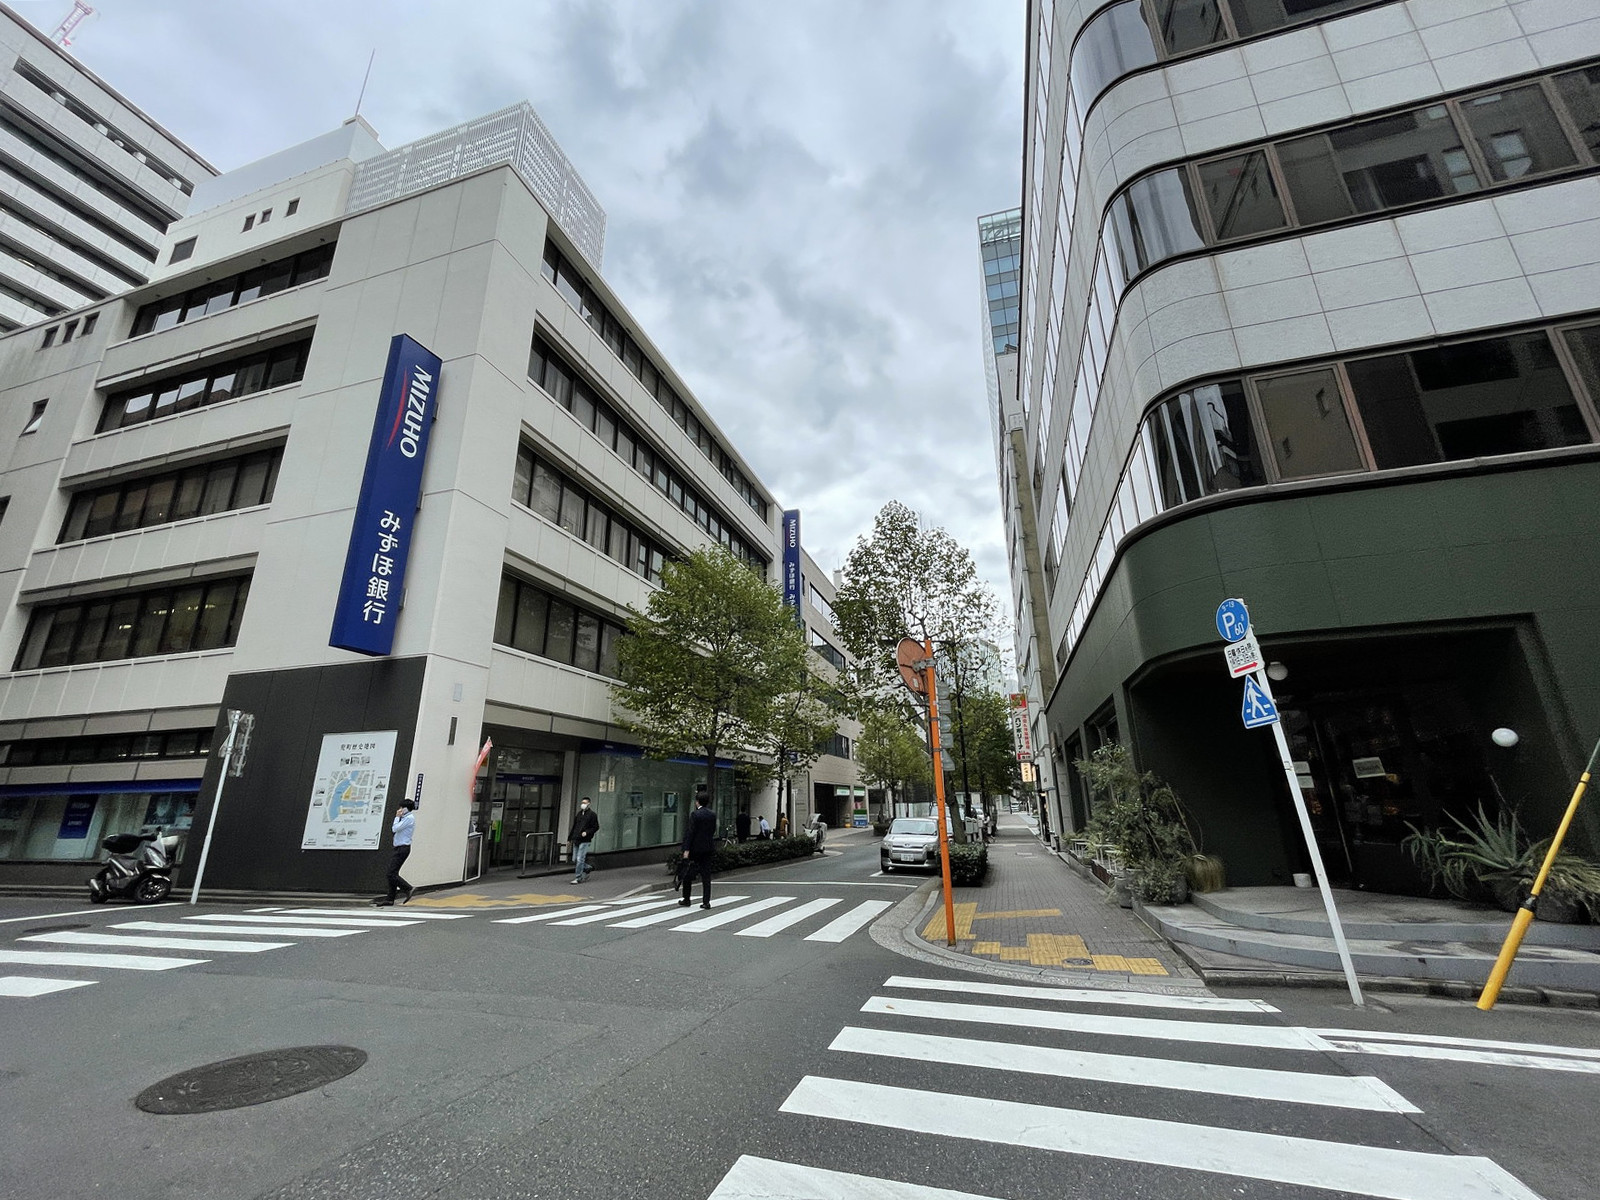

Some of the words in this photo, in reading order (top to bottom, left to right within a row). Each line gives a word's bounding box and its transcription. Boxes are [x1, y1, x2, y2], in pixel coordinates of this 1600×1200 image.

[399, 364, 433, 459] MIZUHO
[362, 509, 401, 625] みずほ銀行
[1222, 612, 1235, 639] P
[1234, 622, 1245, 636] 60
